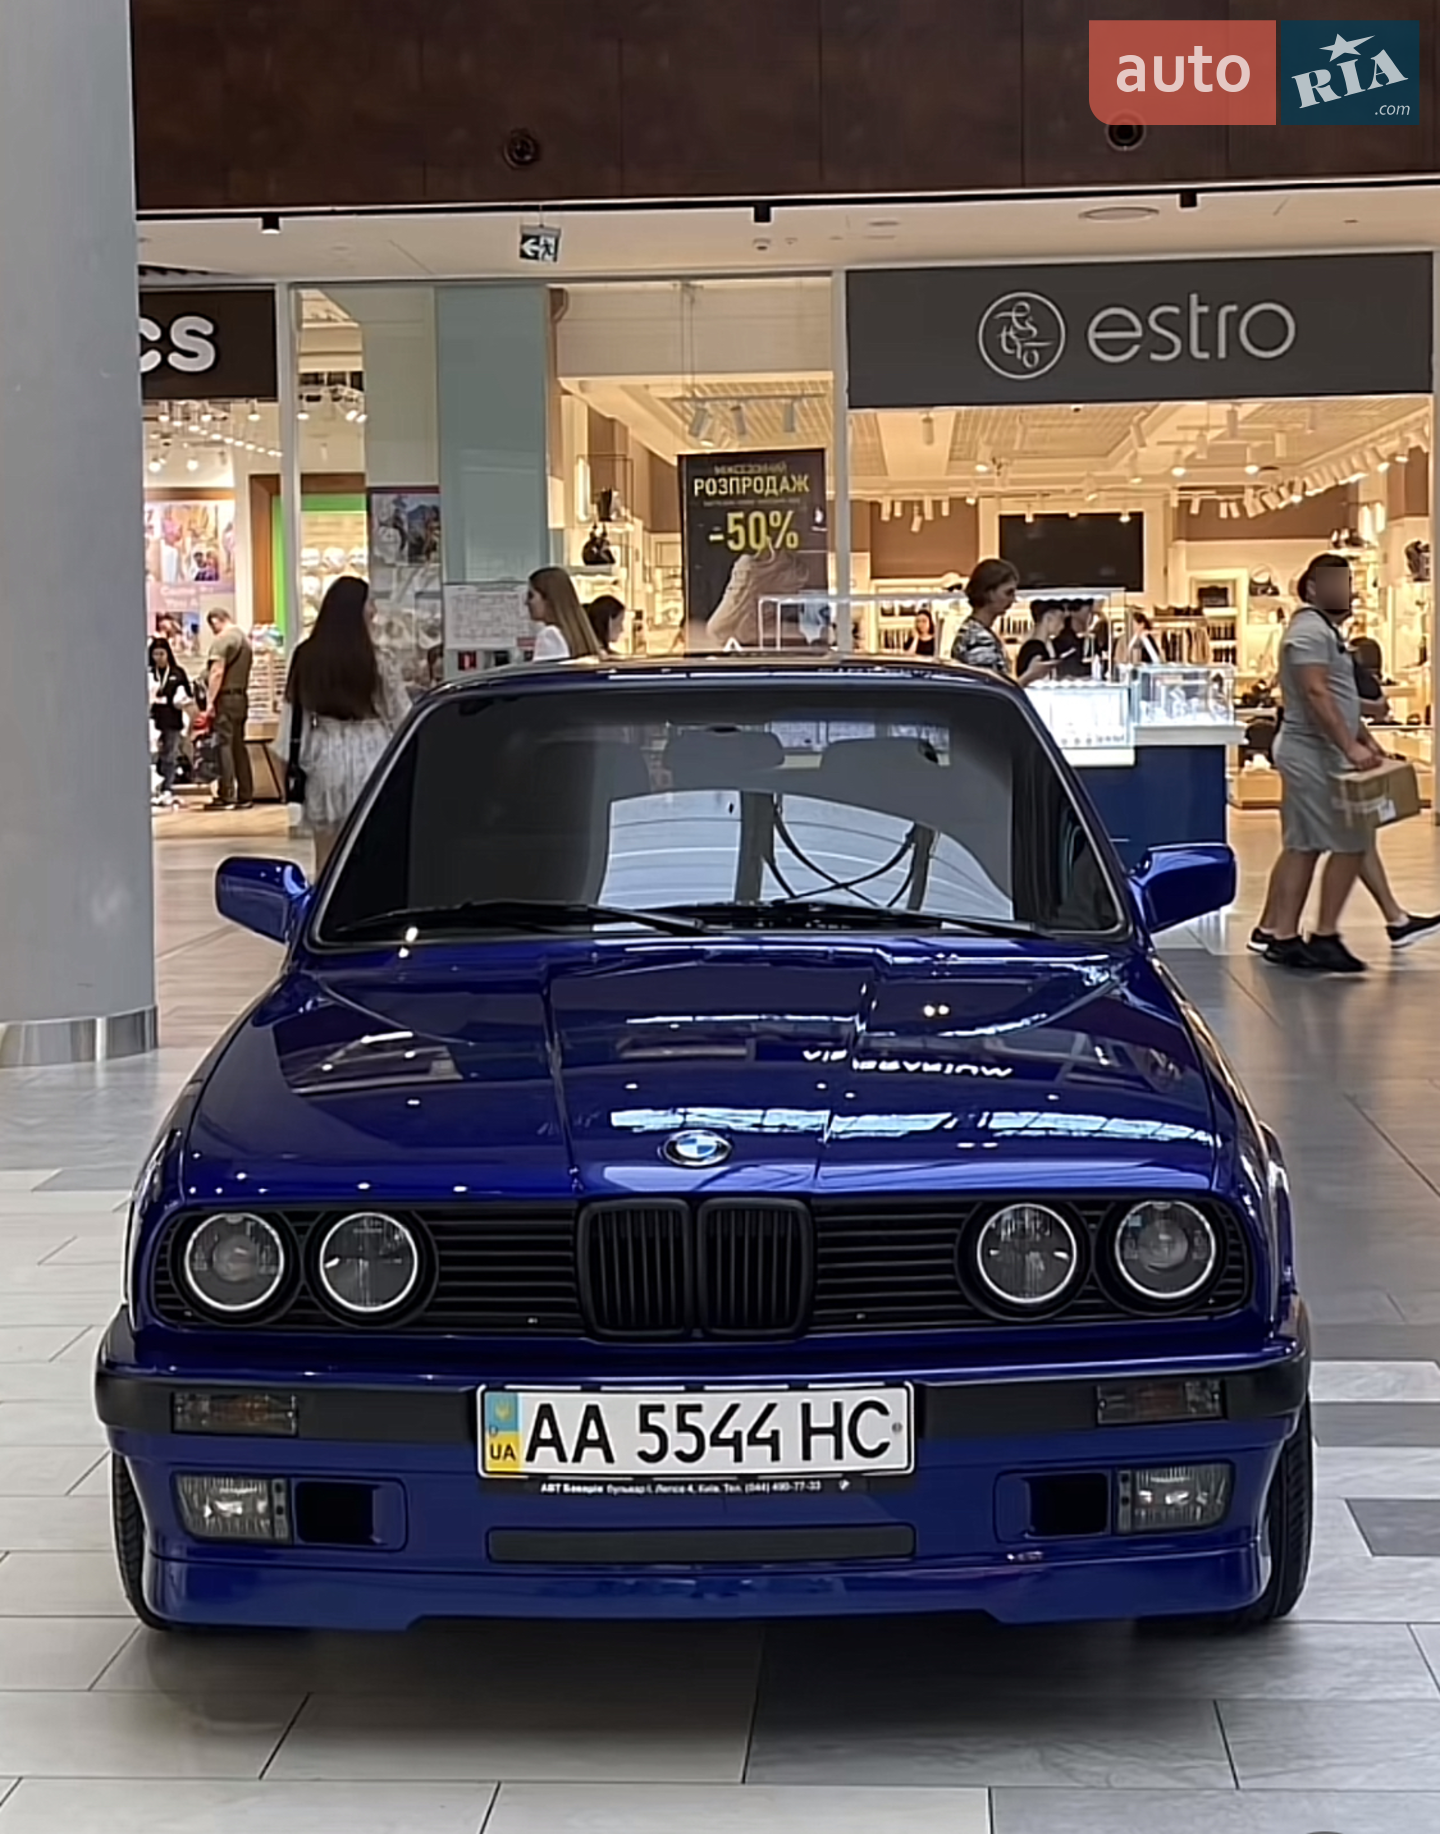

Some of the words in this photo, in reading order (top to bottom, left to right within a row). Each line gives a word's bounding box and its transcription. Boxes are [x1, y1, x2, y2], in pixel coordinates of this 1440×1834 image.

[1086, 293, 1296, 363] estro
[694, 474, 810, 497] РОЗПРОДАЖ
[708, 510, 799, 551] -50%
[490, 1444, 516, 1461] UA
[525, 1402, 615, 1464] AA
[637, 1403, 780, 1464] 5544
[801, 1400, 890, 1461] HC
